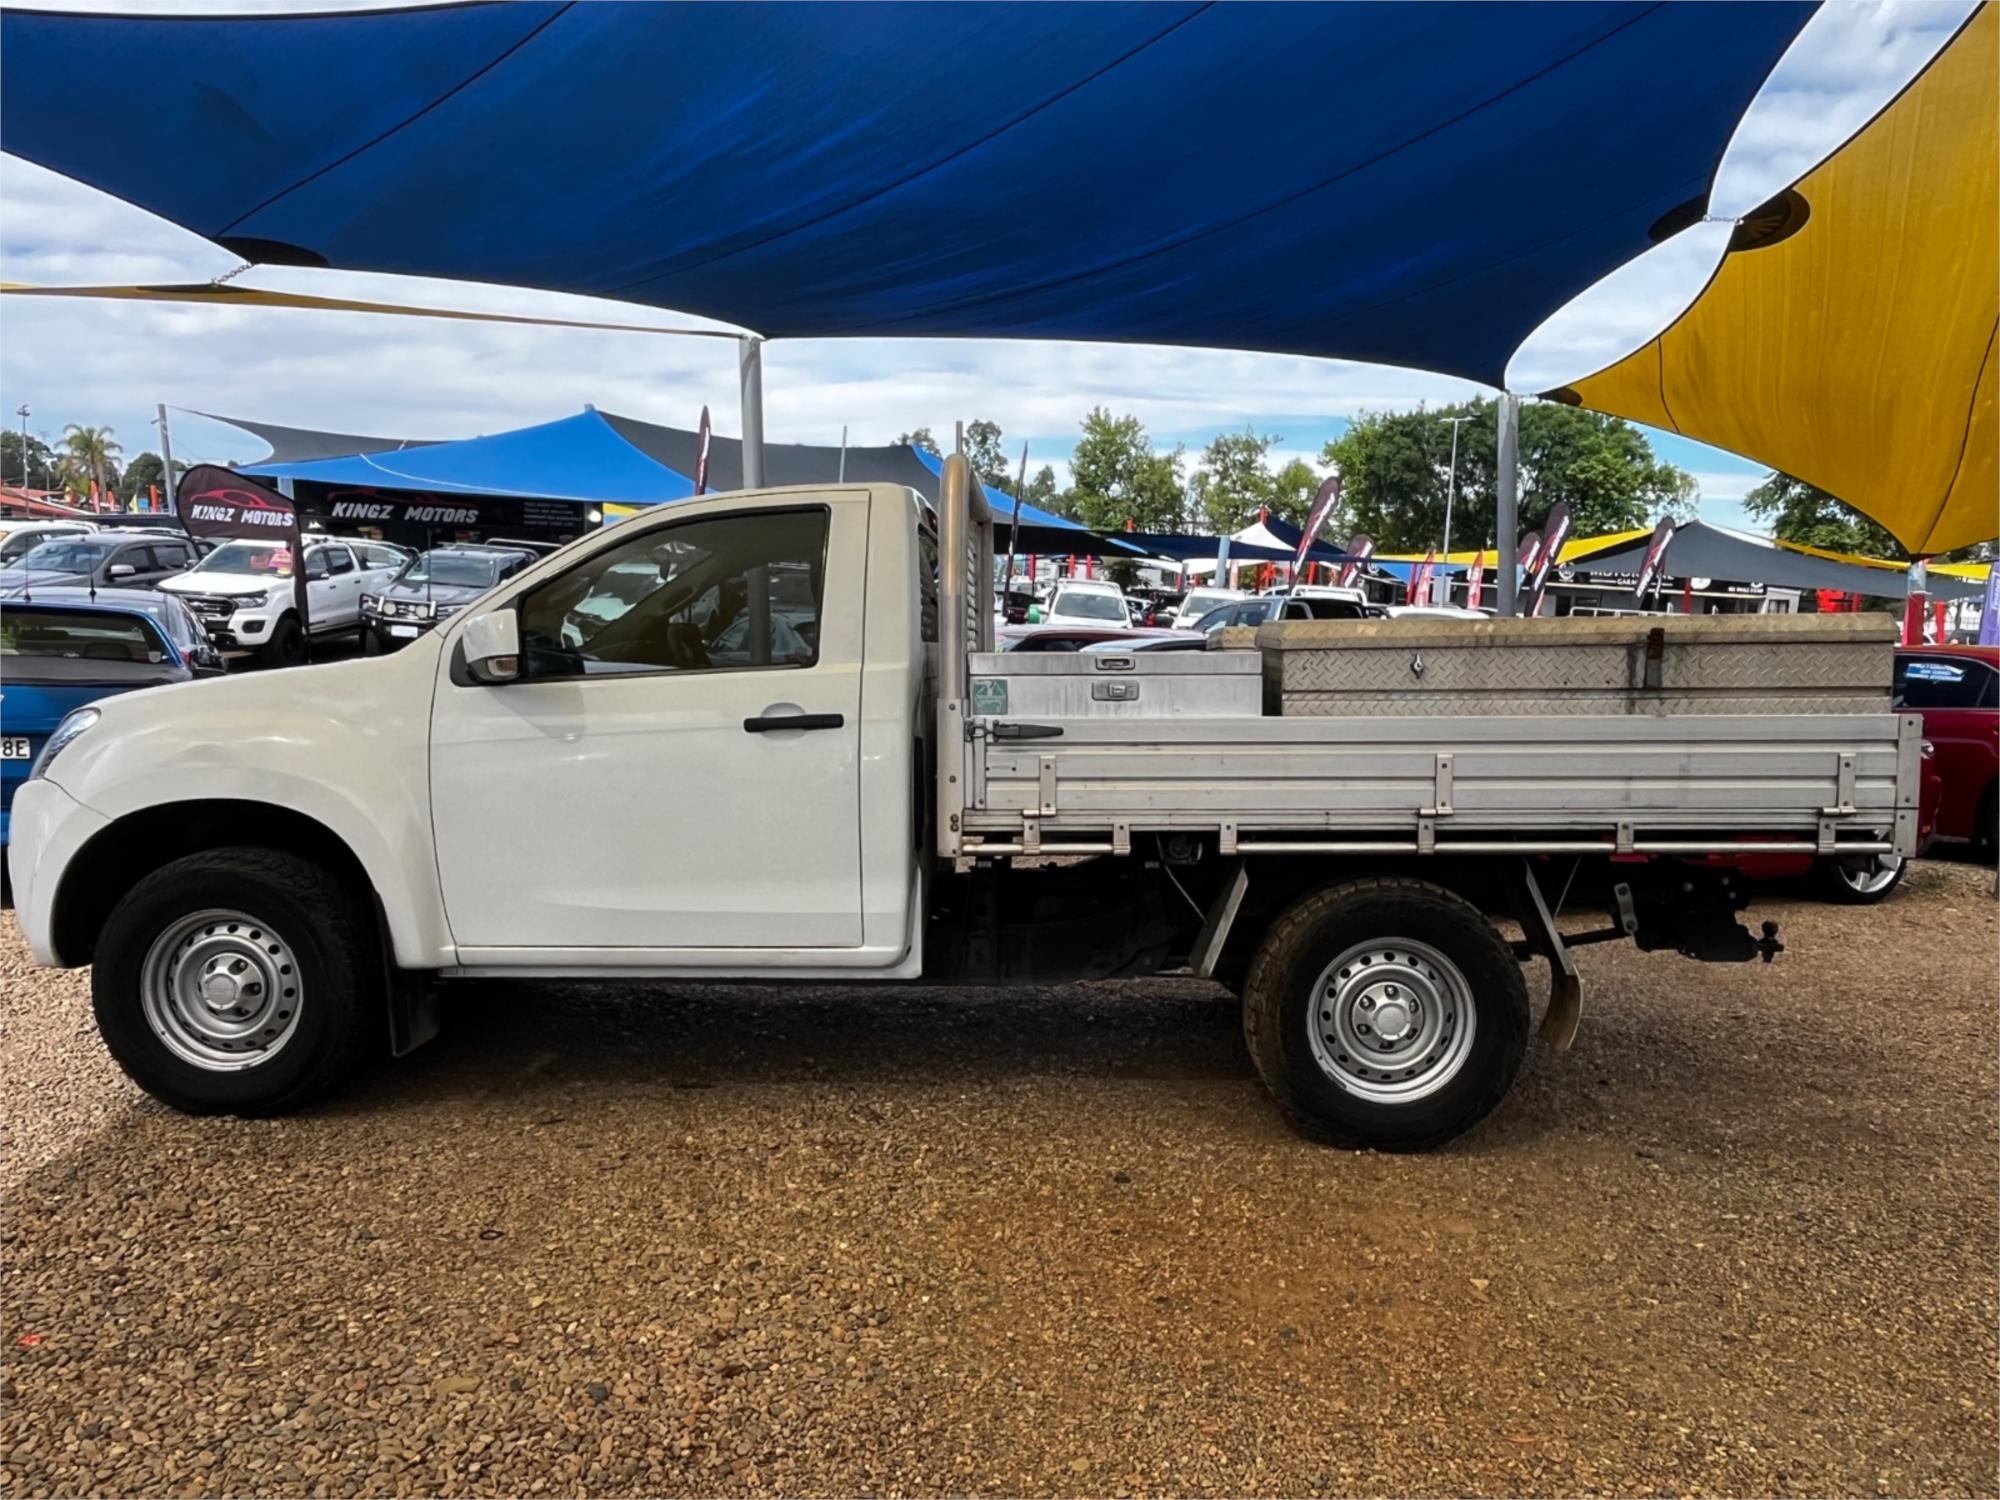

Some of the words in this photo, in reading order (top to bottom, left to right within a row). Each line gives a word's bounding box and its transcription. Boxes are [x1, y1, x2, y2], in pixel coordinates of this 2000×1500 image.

[191, 505, 235, 522] KINGZ
[241, 509, 294, 527] MOTORS
[331, 502, 394, 519] KINGZ
[404, 506, 479, 523] MOTORS
[3, 740, 27, 757] 8E
